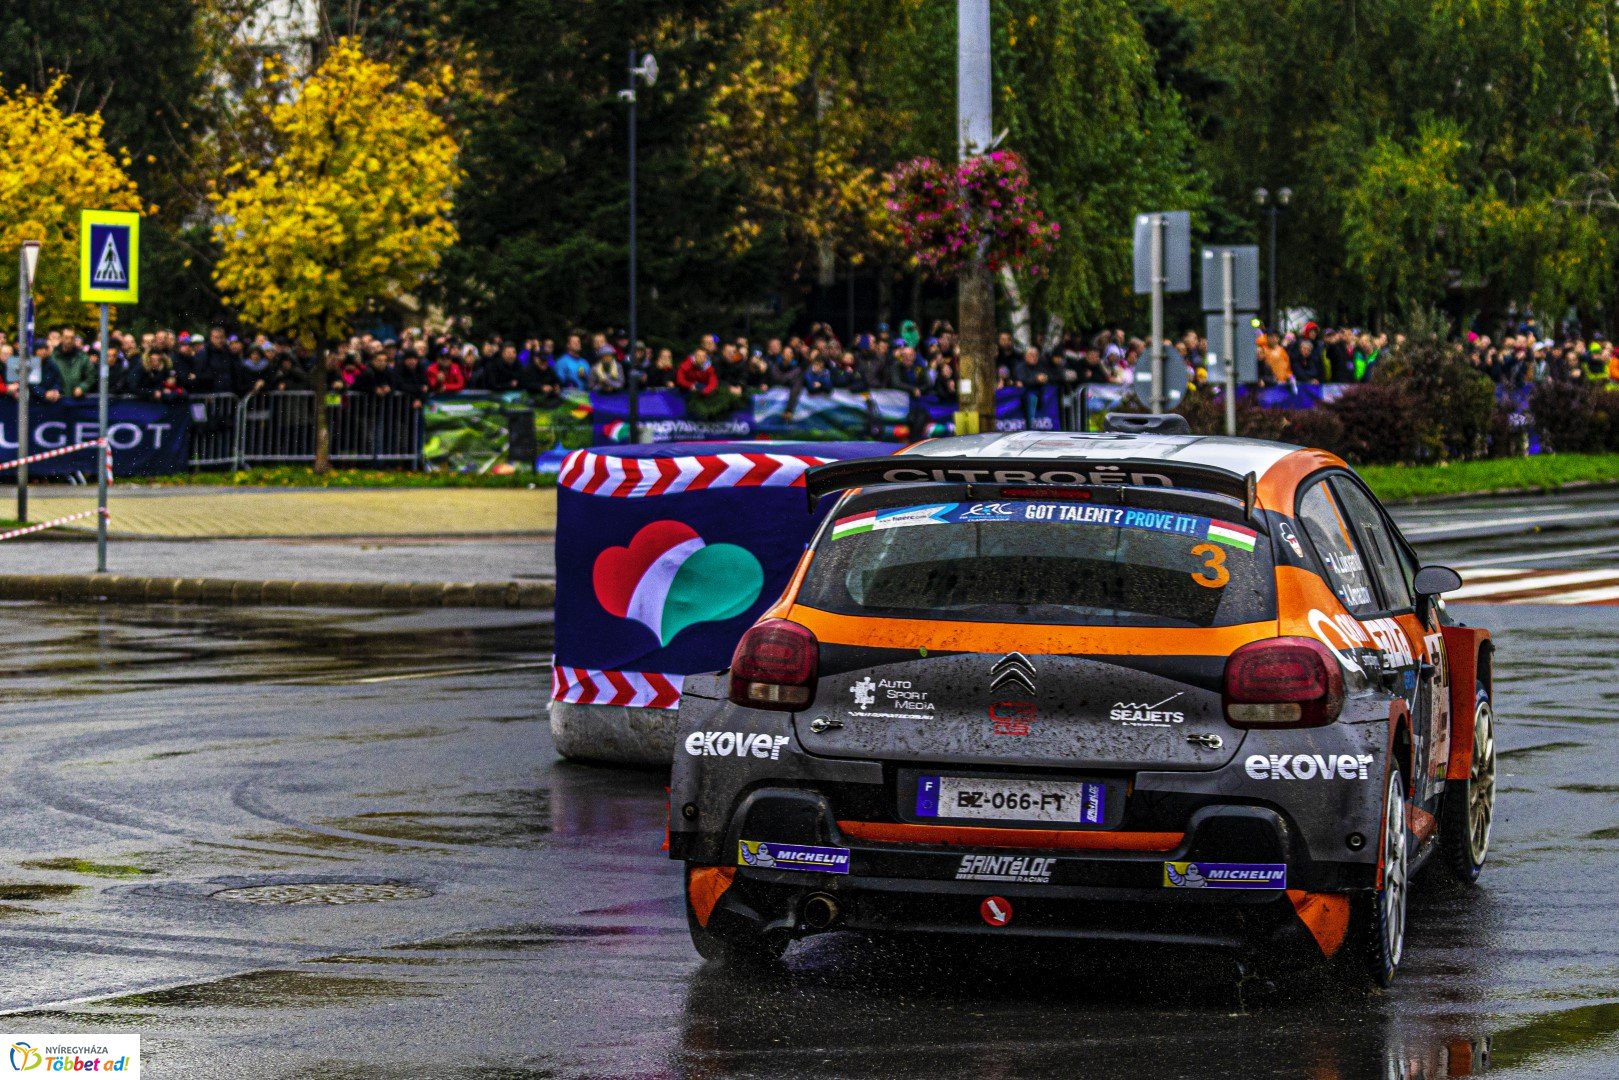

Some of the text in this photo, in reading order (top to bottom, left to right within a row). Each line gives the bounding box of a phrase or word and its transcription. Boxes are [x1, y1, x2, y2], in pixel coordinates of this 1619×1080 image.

[1025, 504, 1198, 534] GOT TALENT? PROVE IT!
[1190, 543, 1231, 589] 3
[1109, 709, 1185, 723] SEAJETS
[684, 731, 791, 760] ekover
[1244, 754, 1374, 780] ekover
[924, 781, 934, 792] F
[777, 850, 848, 864] MICHELIN
[1016, 875, 1050, 883] RACING
[1208, 870, 1284, 879] MICHELIN
